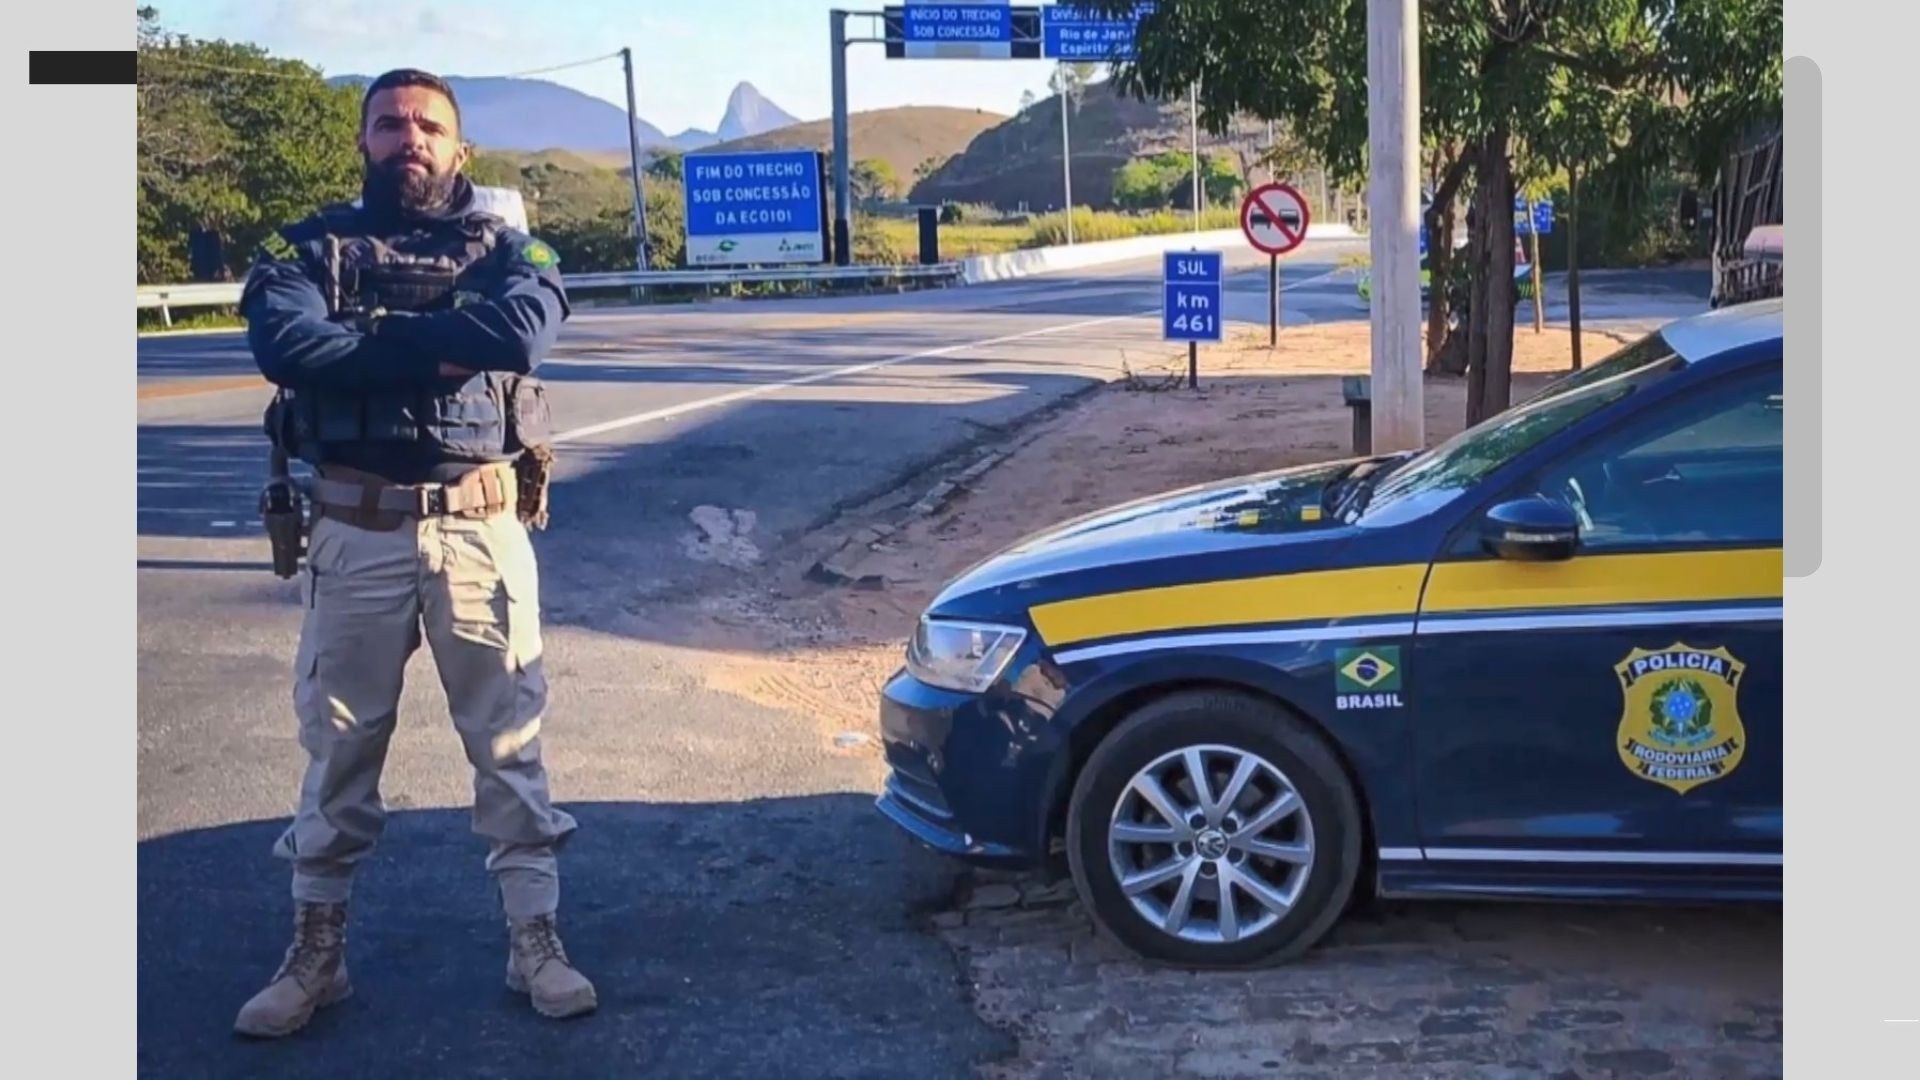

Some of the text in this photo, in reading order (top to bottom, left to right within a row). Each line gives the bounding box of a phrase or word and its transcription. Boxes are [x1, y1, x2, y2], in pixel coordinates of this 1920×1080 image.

[942, 8, 958, 20] DO
[961, 8, 1002, 20] TRECHO
[913, 25, 935, 38] SOB
[1060, 28, 1080, 40] Rio
[1083, 29, 1099, 40] de
[696, 162, 804, 180] FIM DO TRECHO
[693, 181, 811, 203] SOB CONCESSÃO
[715, 209, 792, 225] DA ECO101
[1177, 260, 1208, 275] SUL
[1177, 291, 1209, 309] km
[1172, 313, 1213, 332] 461
[1336, 693, 1404, 710] BRASIL
[1647, 764, 1715, 779] FEDERAL
